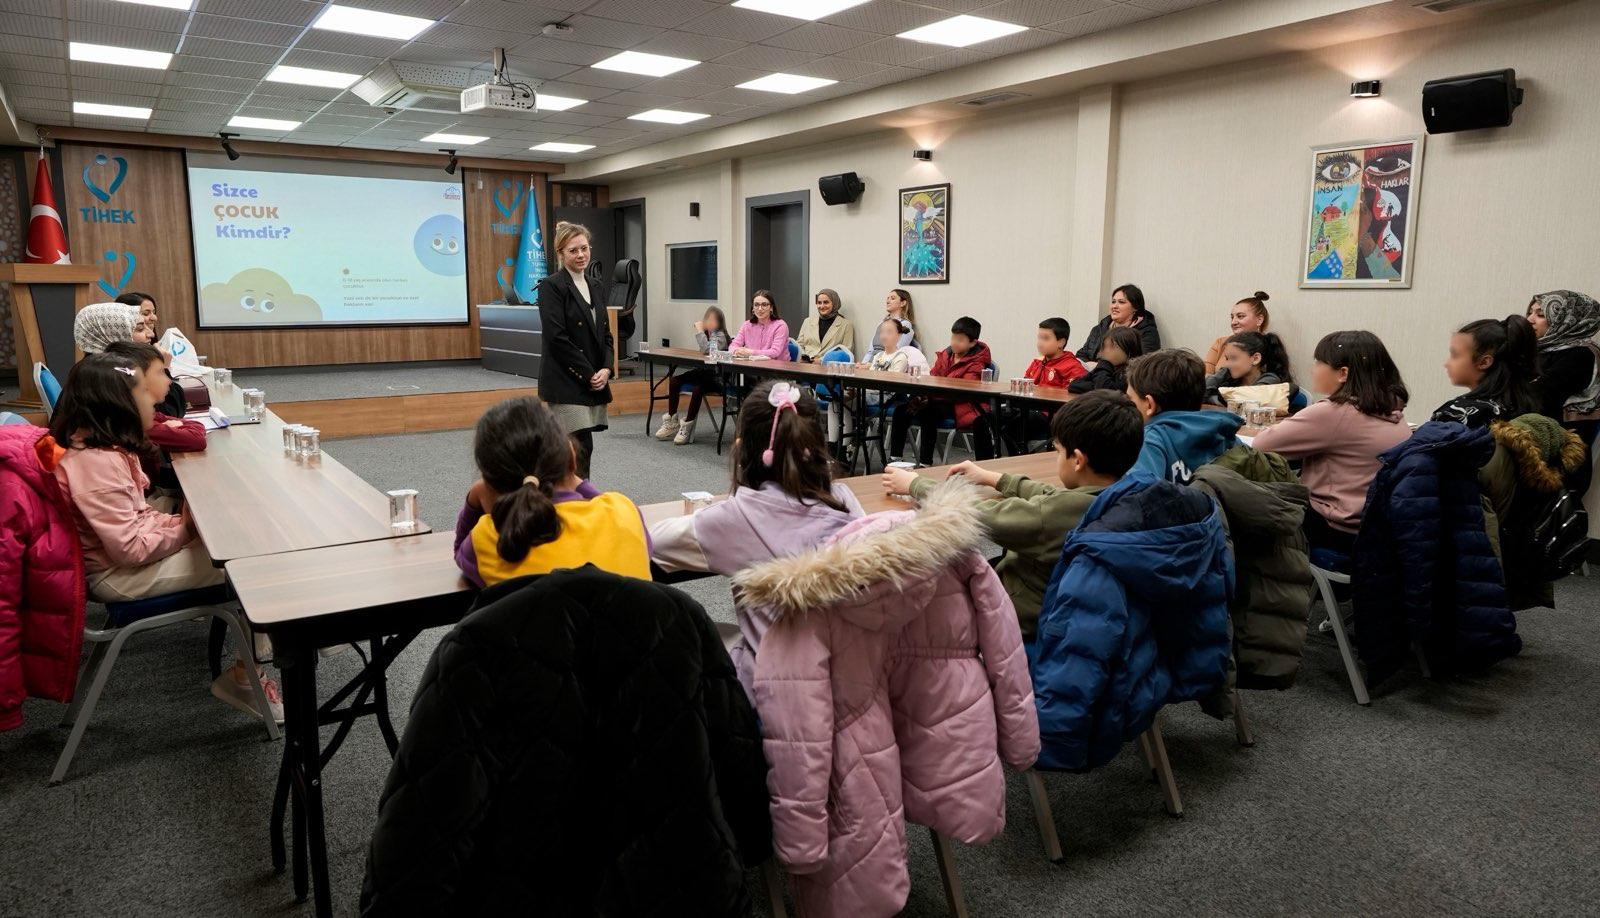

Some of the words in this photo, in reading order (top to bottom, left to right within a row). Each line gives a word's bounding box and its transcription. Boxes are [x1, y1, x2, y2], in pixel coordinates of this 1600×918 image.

[212, 183, 258, 198] Sizce
[79, 206, 136, 224] TİHEK
[213, 204, 279, 221] ÇOCUK
[216, 224, 291, 239] Kimdir?
[490, 222, 521, 235] TİHE
[527, 249, 546, 260] TİHE
